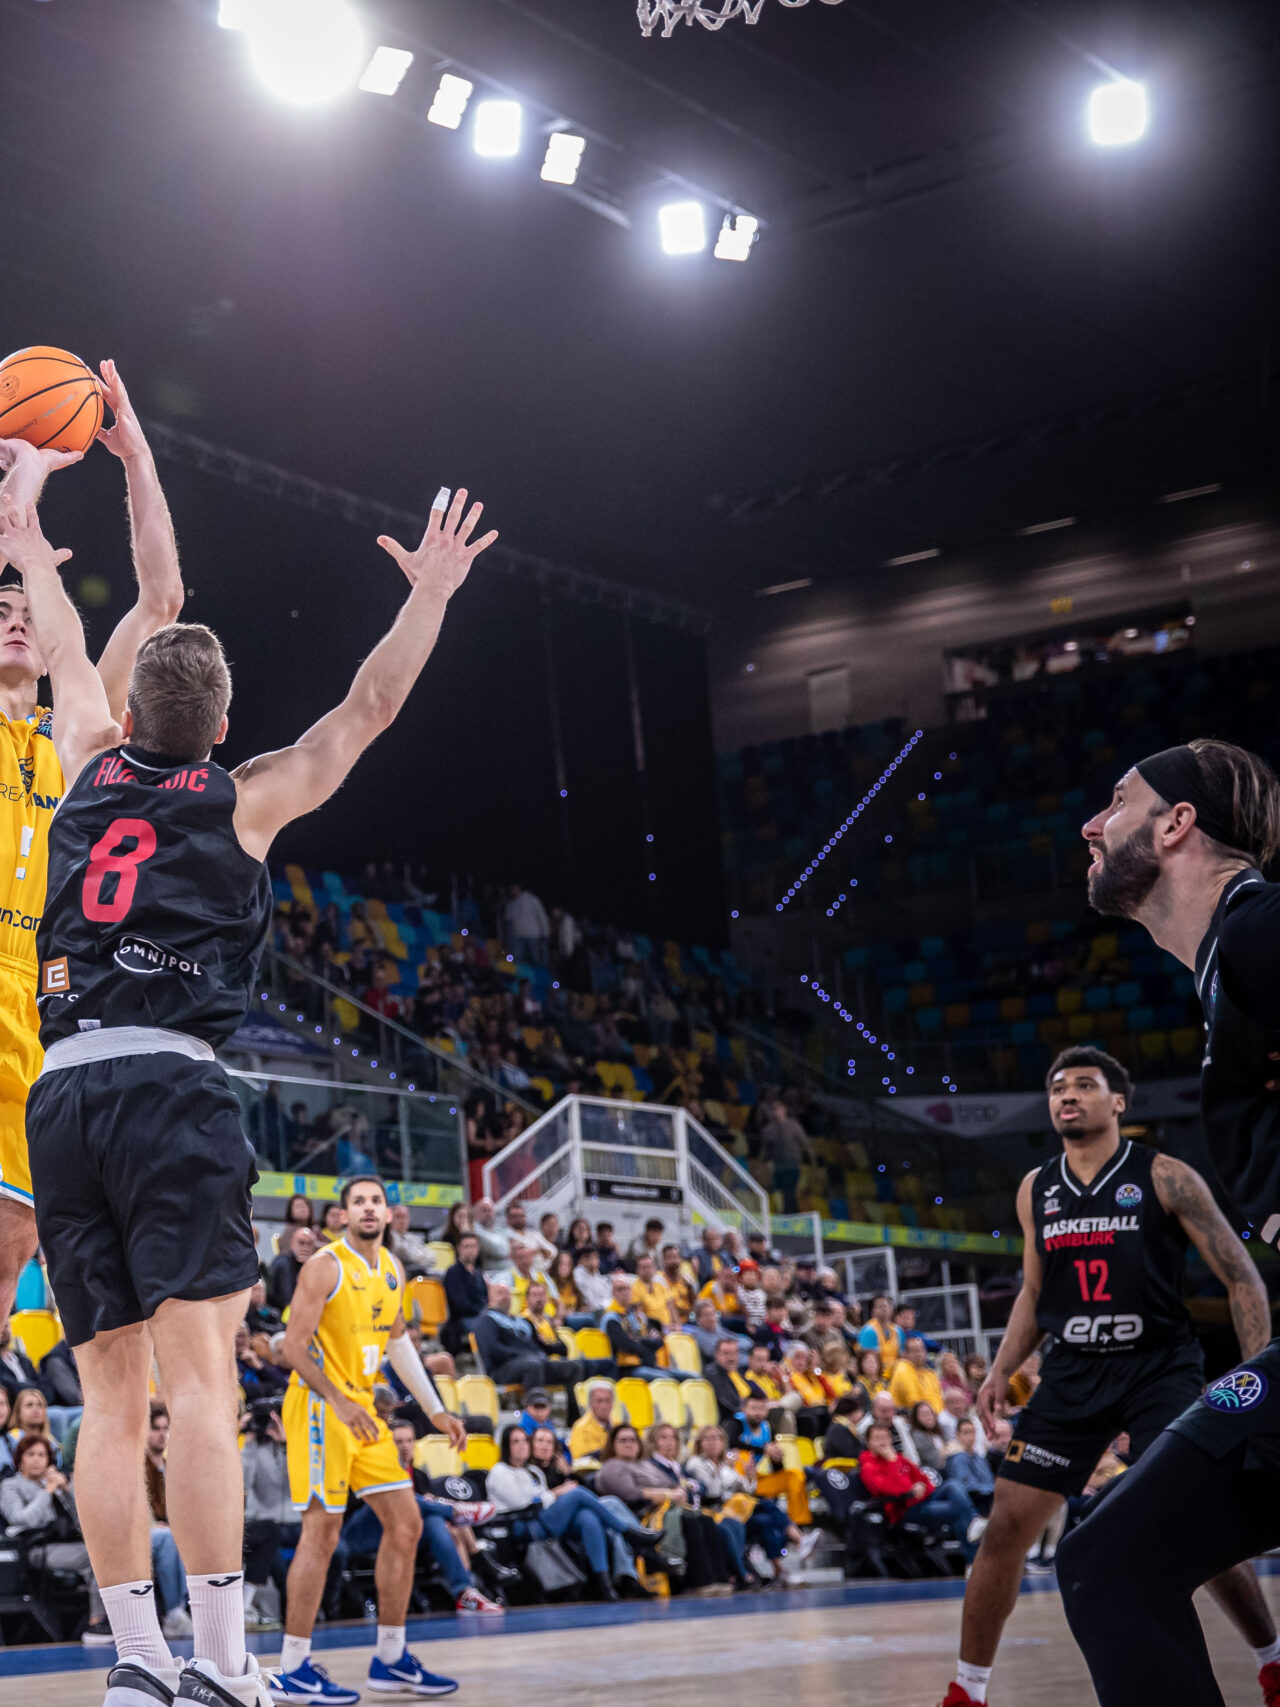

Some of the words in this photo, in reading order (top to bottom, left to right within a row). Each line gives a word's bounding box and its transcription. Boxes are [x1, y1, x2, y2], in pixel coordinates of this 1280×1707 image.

[82, 818, 157, 923] 8
[119, 944, 202, 976] OMNIPOL
[1043, 1215, 1140, 1240] BASKETBALL
[1073, 1258, 1112, 1302] 12
[1063, 1313, 1144, 1343] era
